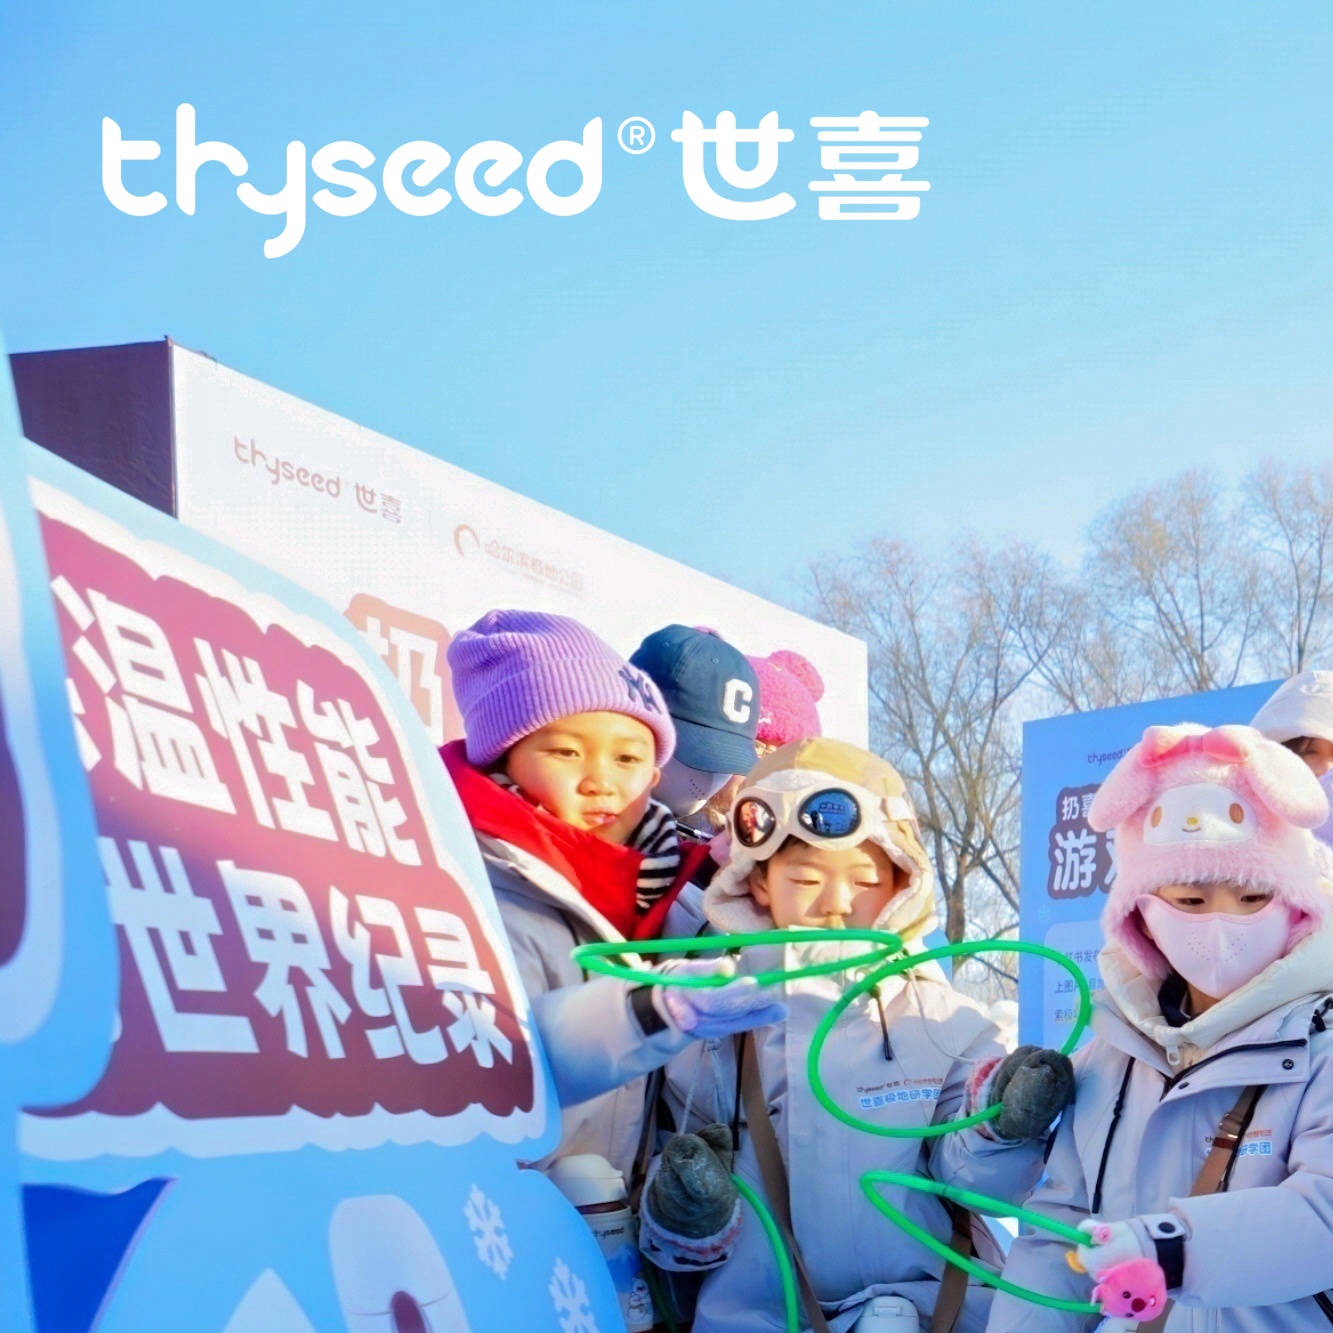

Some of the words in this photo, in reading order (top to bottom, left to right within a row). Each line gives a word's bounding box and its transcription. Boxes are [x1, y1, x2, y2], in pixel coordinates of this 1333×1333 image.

[233, 434, 341, 499] thyseed
[353, 481, 402, 524] 世喜
[722, 678, 753, 724] C
[97, 836, 513, 1068] 世界纪录
